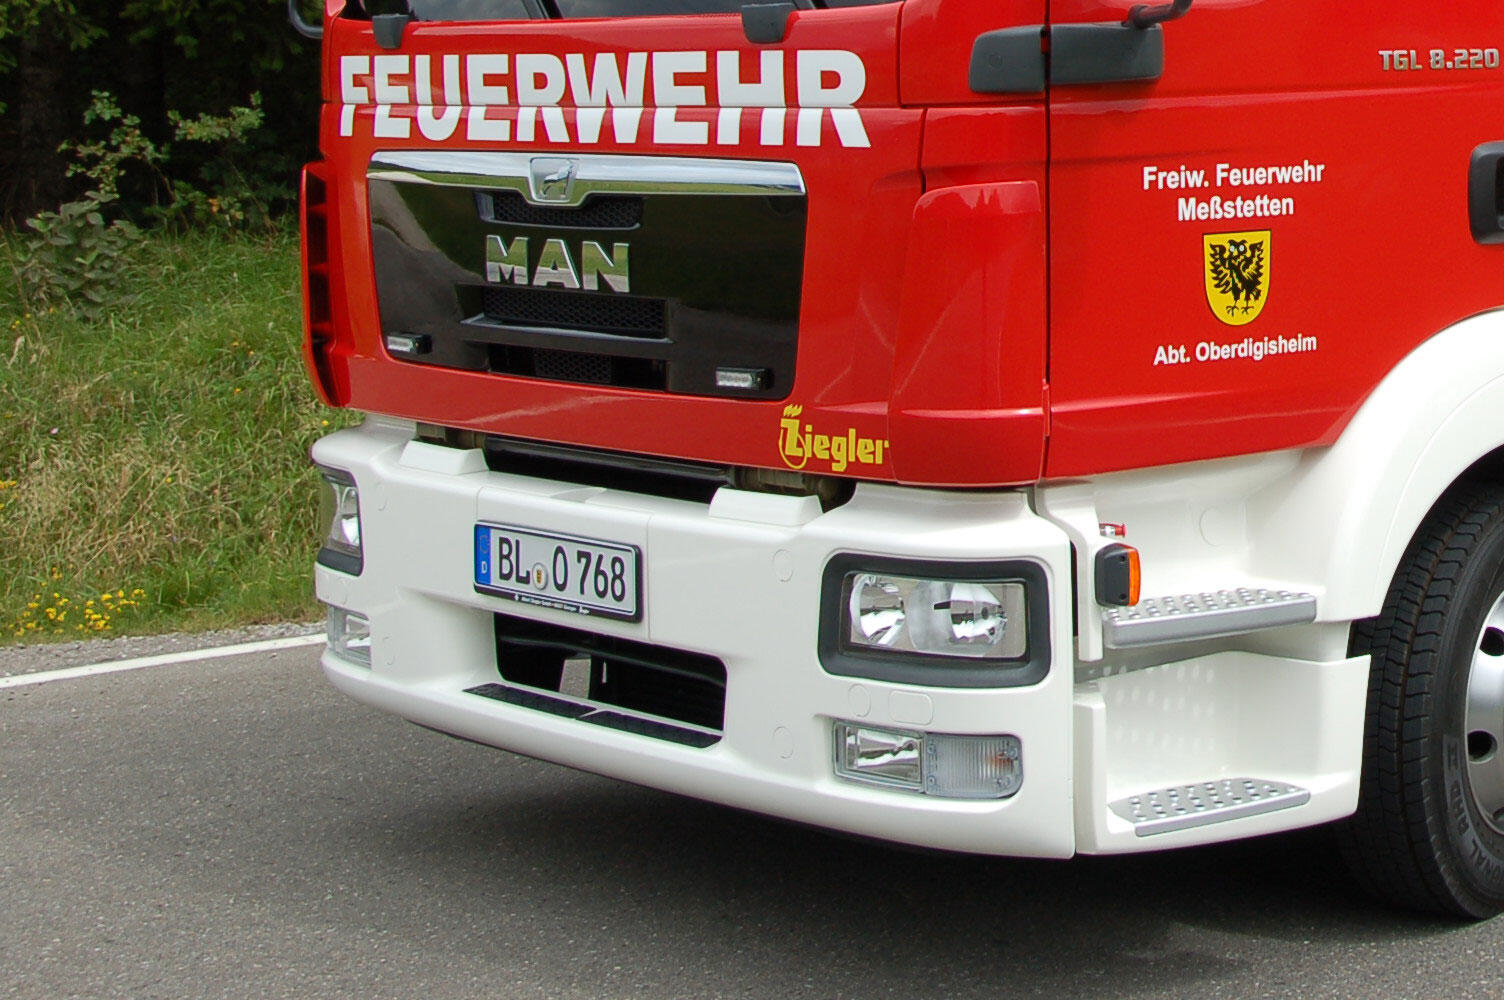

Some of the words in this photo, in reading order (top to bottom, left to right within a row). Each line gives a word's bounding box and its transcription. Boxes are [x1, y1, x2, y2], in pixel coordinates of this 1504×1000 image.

[1378, 49, 1423, 71] TGL
[1429, 48, 1500, 69] 8.220
[339, 49, 872, 148] FEUERWEHR
[1143, 165, 1209, 190] Freiw.
[1216, 159, 1326, 187] Feuerwehr
[1177, 195, 1295, 221] Meßstetten
[486, 234, 631, 293] MAN
[1153, 344, 1191, 366] Abt.
[1195, 333, 1317, 361] Oberdigisheim
[779, 418, 890, 472] Ziegler
[481, 561, 488, 574] D
[498, 536, 531, 584] BL
[576, 549, 626, 602] 768
